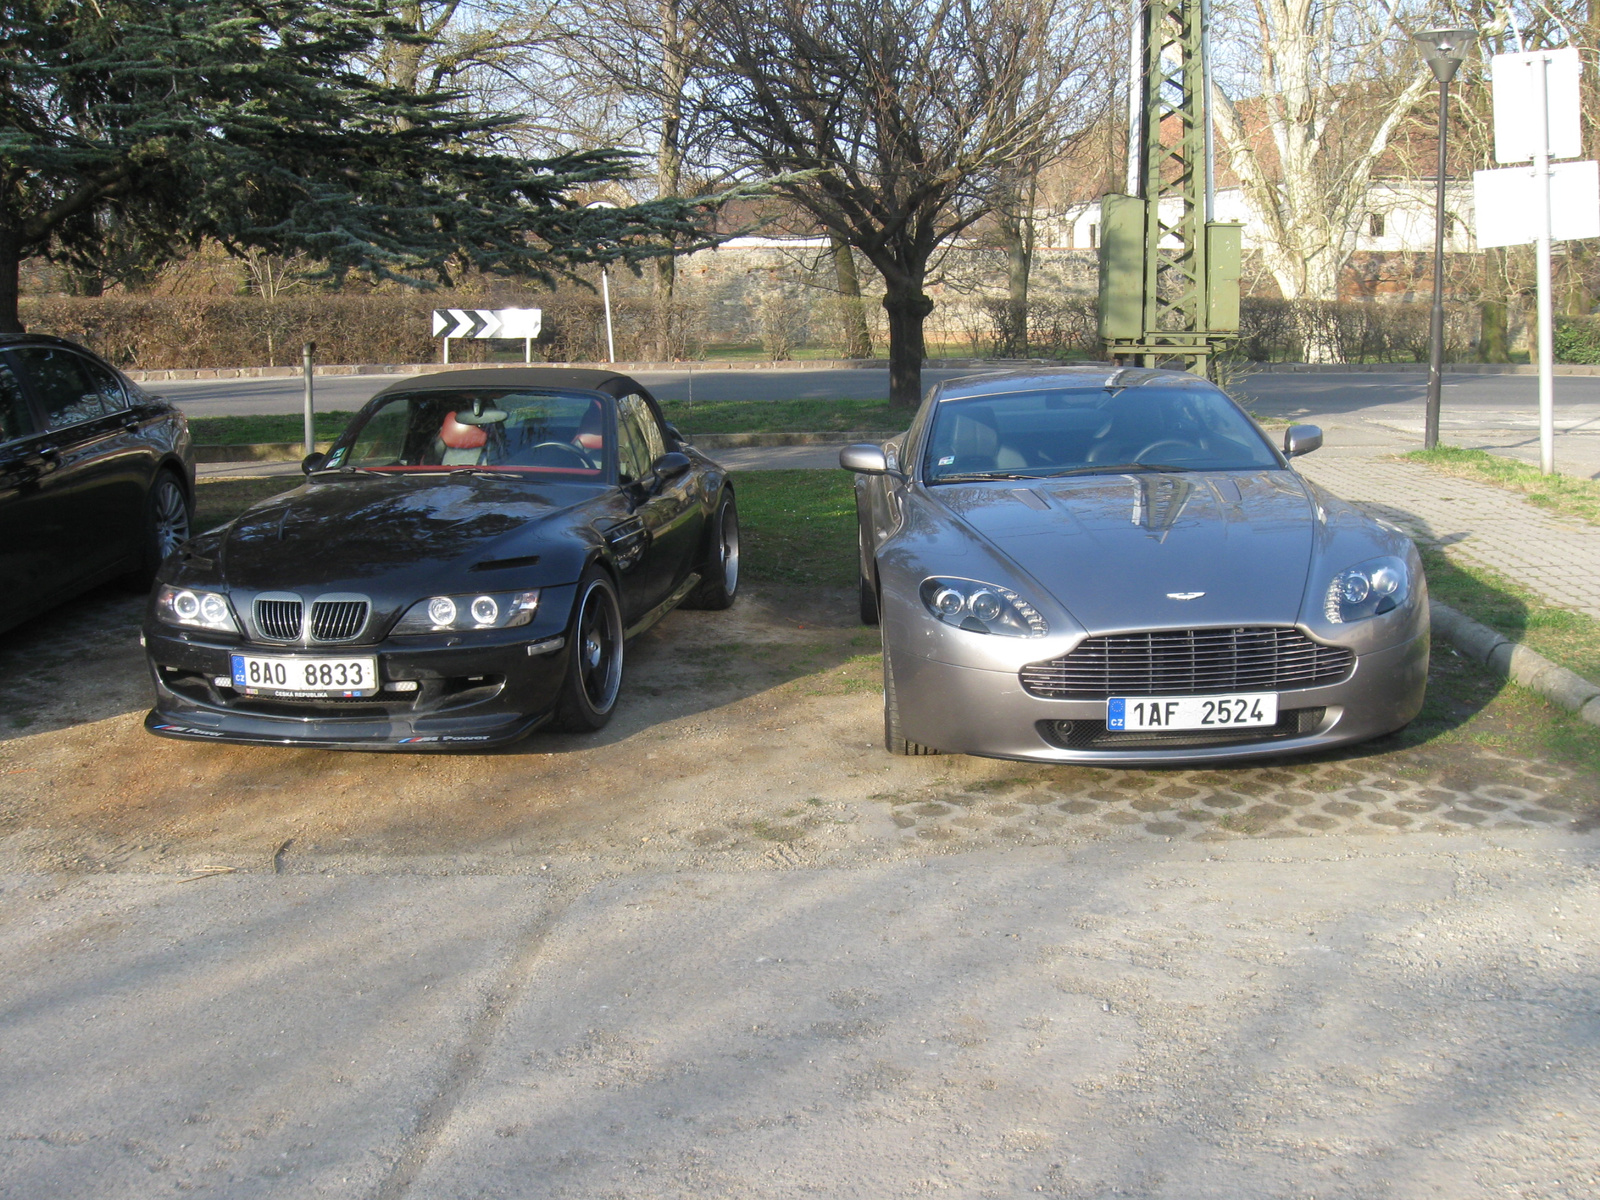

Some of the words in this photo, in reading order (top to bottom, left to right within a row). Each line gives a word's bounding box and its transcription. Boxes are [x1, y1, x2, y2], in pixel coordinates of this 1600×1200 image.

[235, 674, 245, 682] CZ
[305, 663, 363, 686] 8833
[1133, 702, 1179, 726] 1AF
[1201, 698, 1264, 725] 2524
[1110, 718, 1123, 726] CZ
